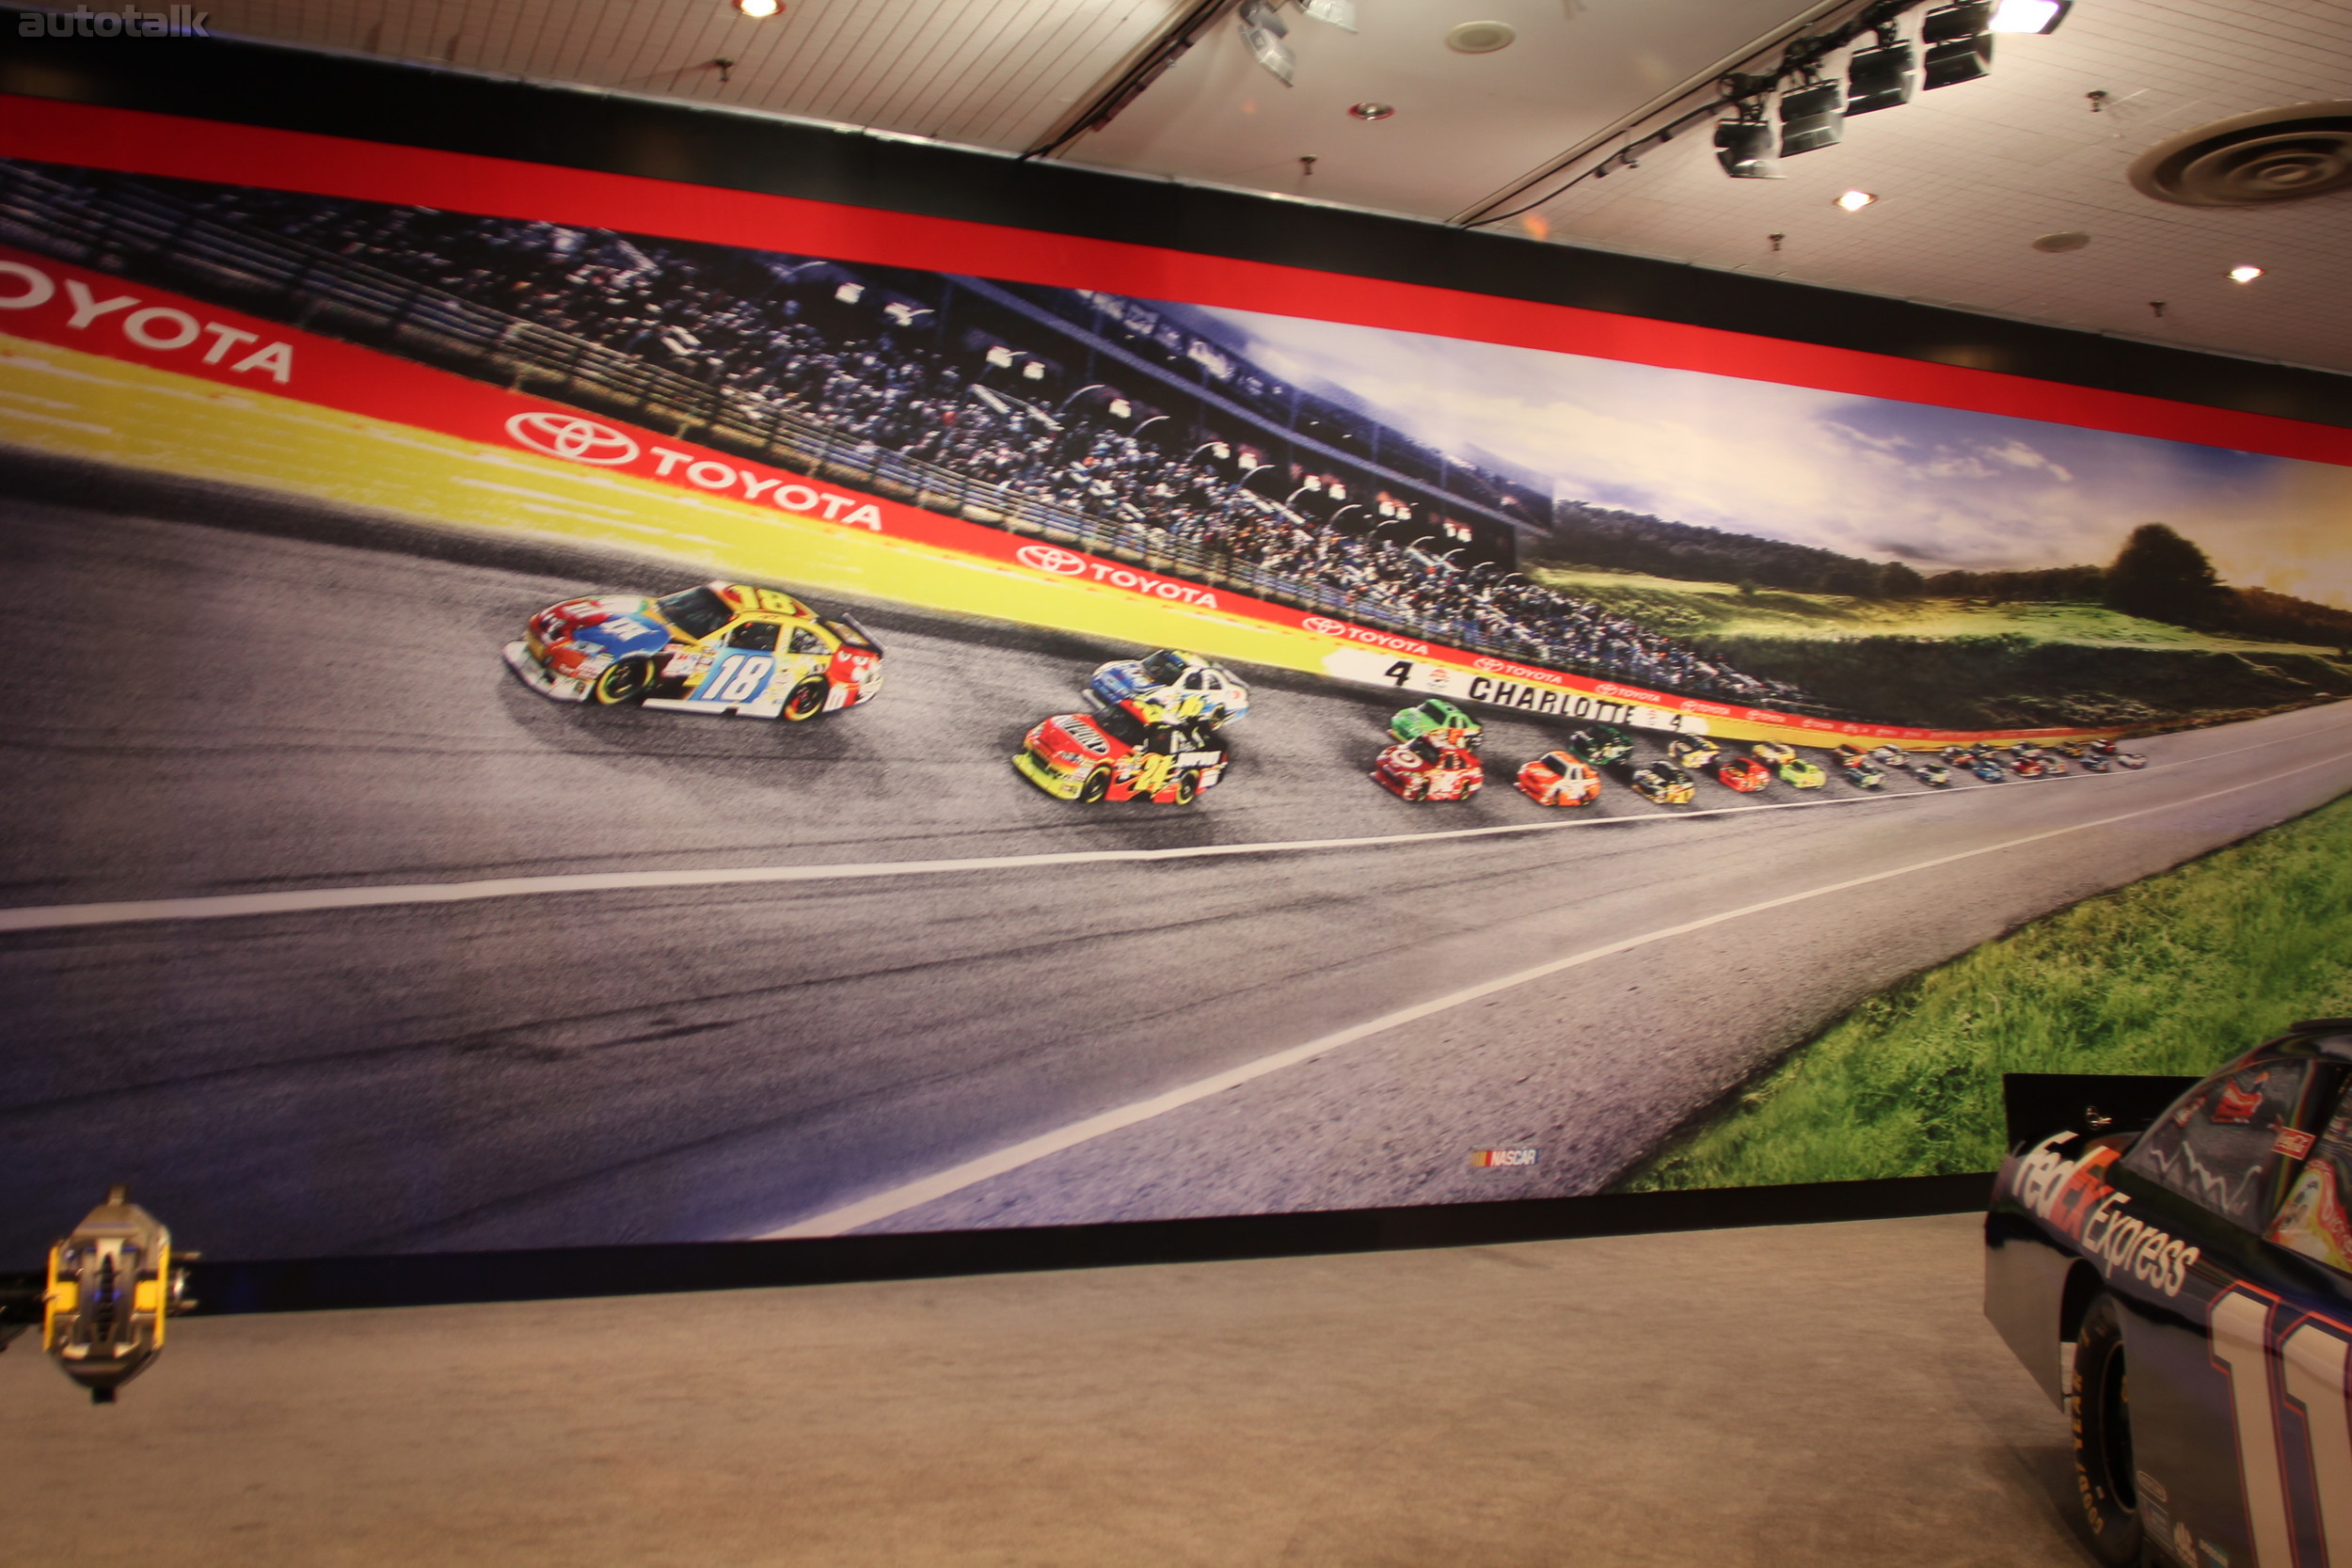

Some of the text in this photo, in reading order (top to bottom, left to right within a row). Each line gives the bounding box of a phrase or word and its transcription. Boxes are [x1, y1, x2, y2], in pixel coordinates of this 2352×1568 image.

[649, 446, 882, 531] TOYOTA
[726, 584, 797, 615] 18
[1089, 562, 1218, 609] TOYOTA
[1347, 627, 1429, 656] TOYOTA
[699, 654, 775, 701] 18
[1384, 660, 1414, 687] 4
[1505, 664, 1563, 684] TOYOTA
[1469, 675, 1636, 724] CHARLOTTE
[1490, 1149, 1537, 1166] NASCAR
[2011, 1131, 2122, 1242] FedEx
[2081, 1191, 2201, 1297] Express
